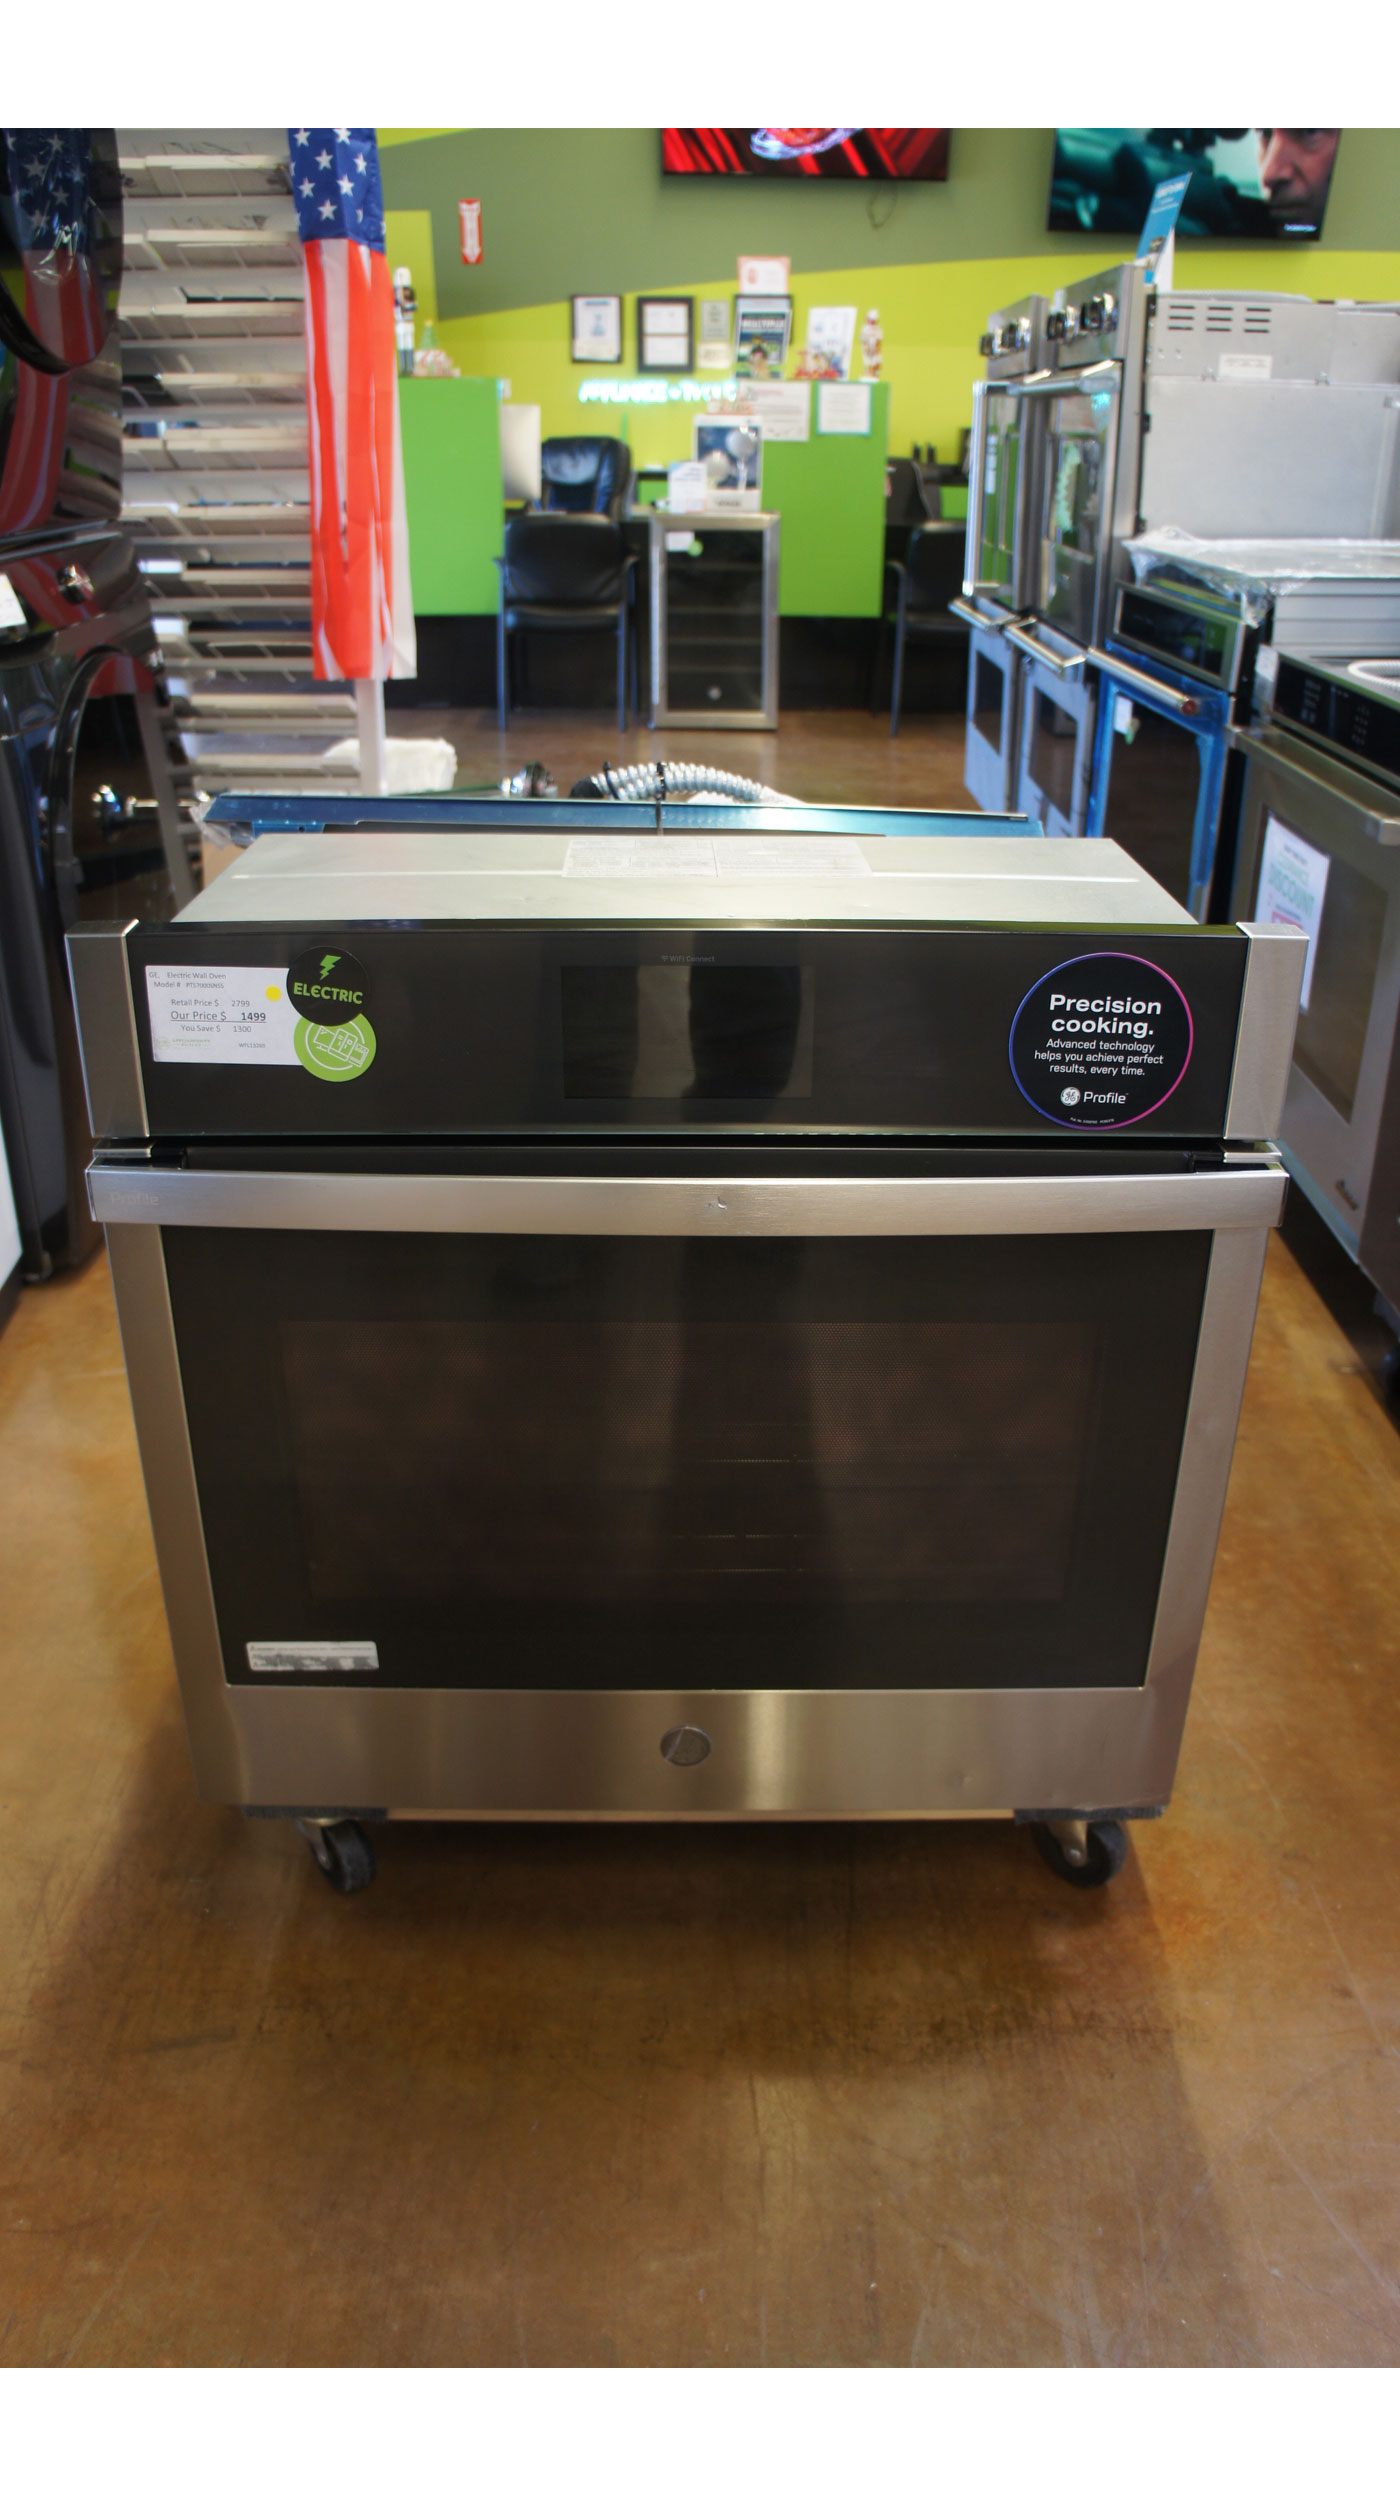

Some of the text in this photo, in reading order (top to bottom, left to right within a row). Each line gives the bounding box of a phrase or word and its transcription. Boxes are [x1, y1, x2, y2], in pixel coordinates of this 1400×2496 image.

[167, 971, 190, 979] Electric
[293, 982, 363, 1005] ELECTRIC
[171, 999, 193, 1007] Retail
[194, 999, 212, 1007] Price
[231, 1000, 250, 1008] 2799
[1050, 994, 1162, 1015] Precision
[170, 1011, 190, 1020] Our
[193, 1011, 218, 1020] Price
[241, 1012, 267, 1021] 1499
[181, 1024, 195, 1032] You
[233, 1025, 252, 1033] 1300
[1051, 1017, 1154, 1039] cooking.
[1046, 1038, 1155, 1053] Advanced technology
[1034, 1050, 1164, 1065] helps you achieve perfect
[1049, 1064, 1146, 1076] results, every time.
[1083, 1091, 1127, 1104] Profile
